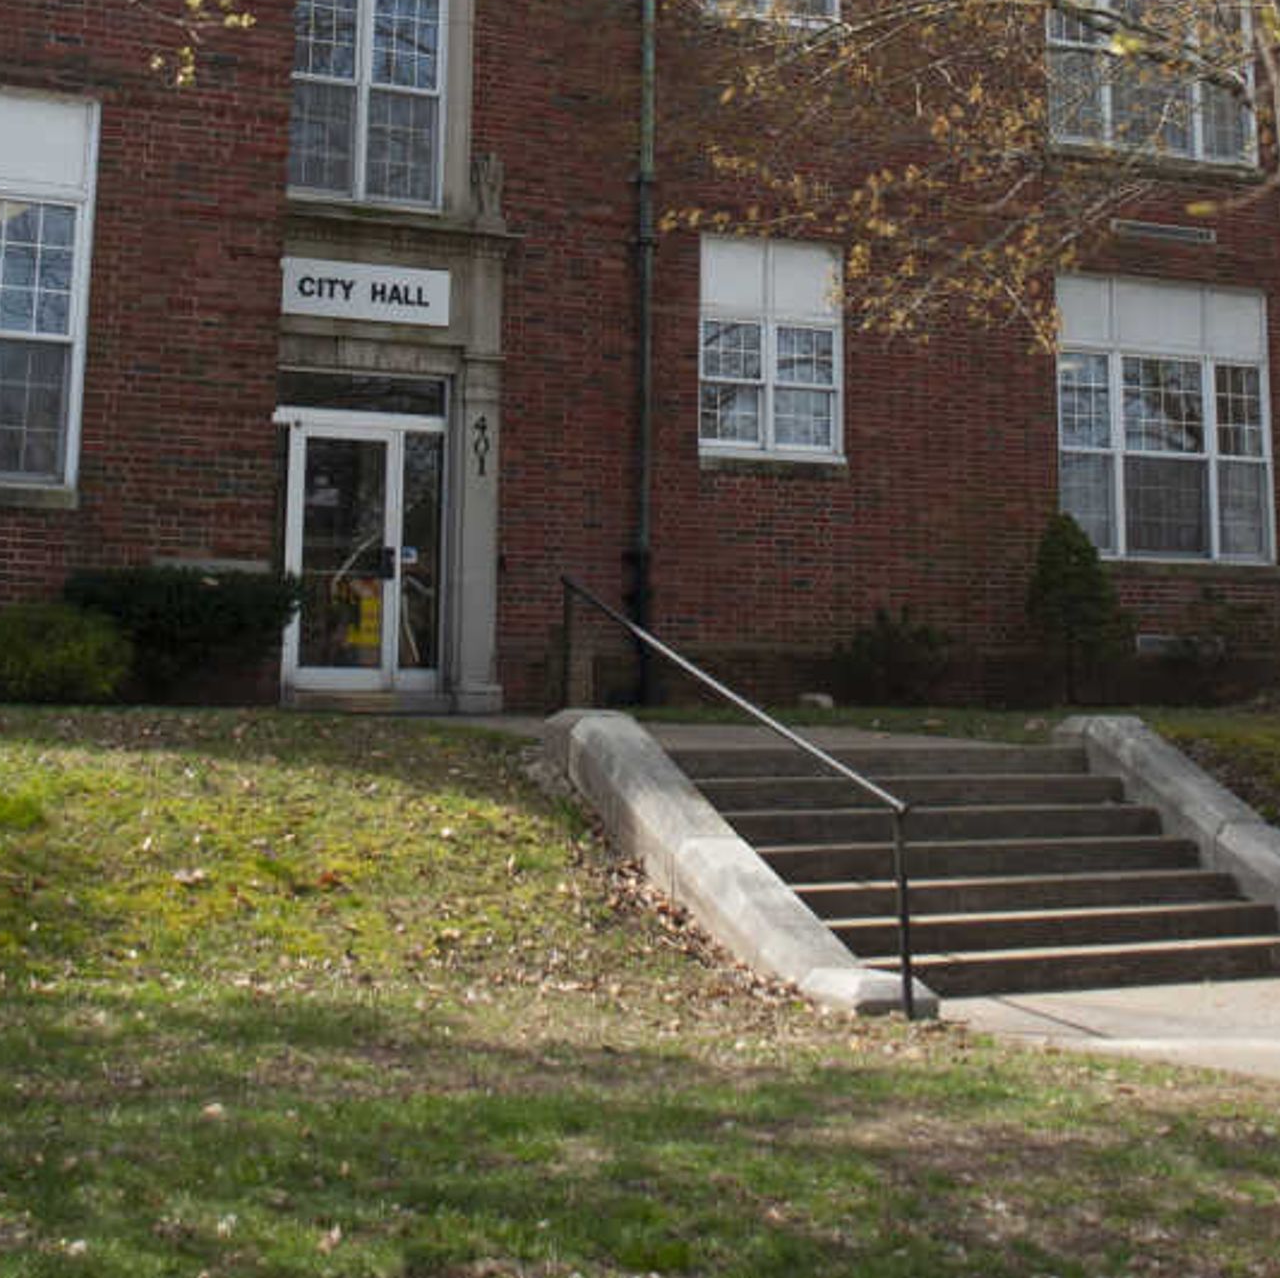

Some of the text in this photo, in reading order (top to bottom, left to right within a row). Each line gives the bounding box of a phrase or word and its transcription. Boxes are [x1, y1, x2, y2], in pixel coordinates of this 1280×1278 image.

[298, 277, 430, 307] CITY HALL
[474, 415, 490, 476] 401
